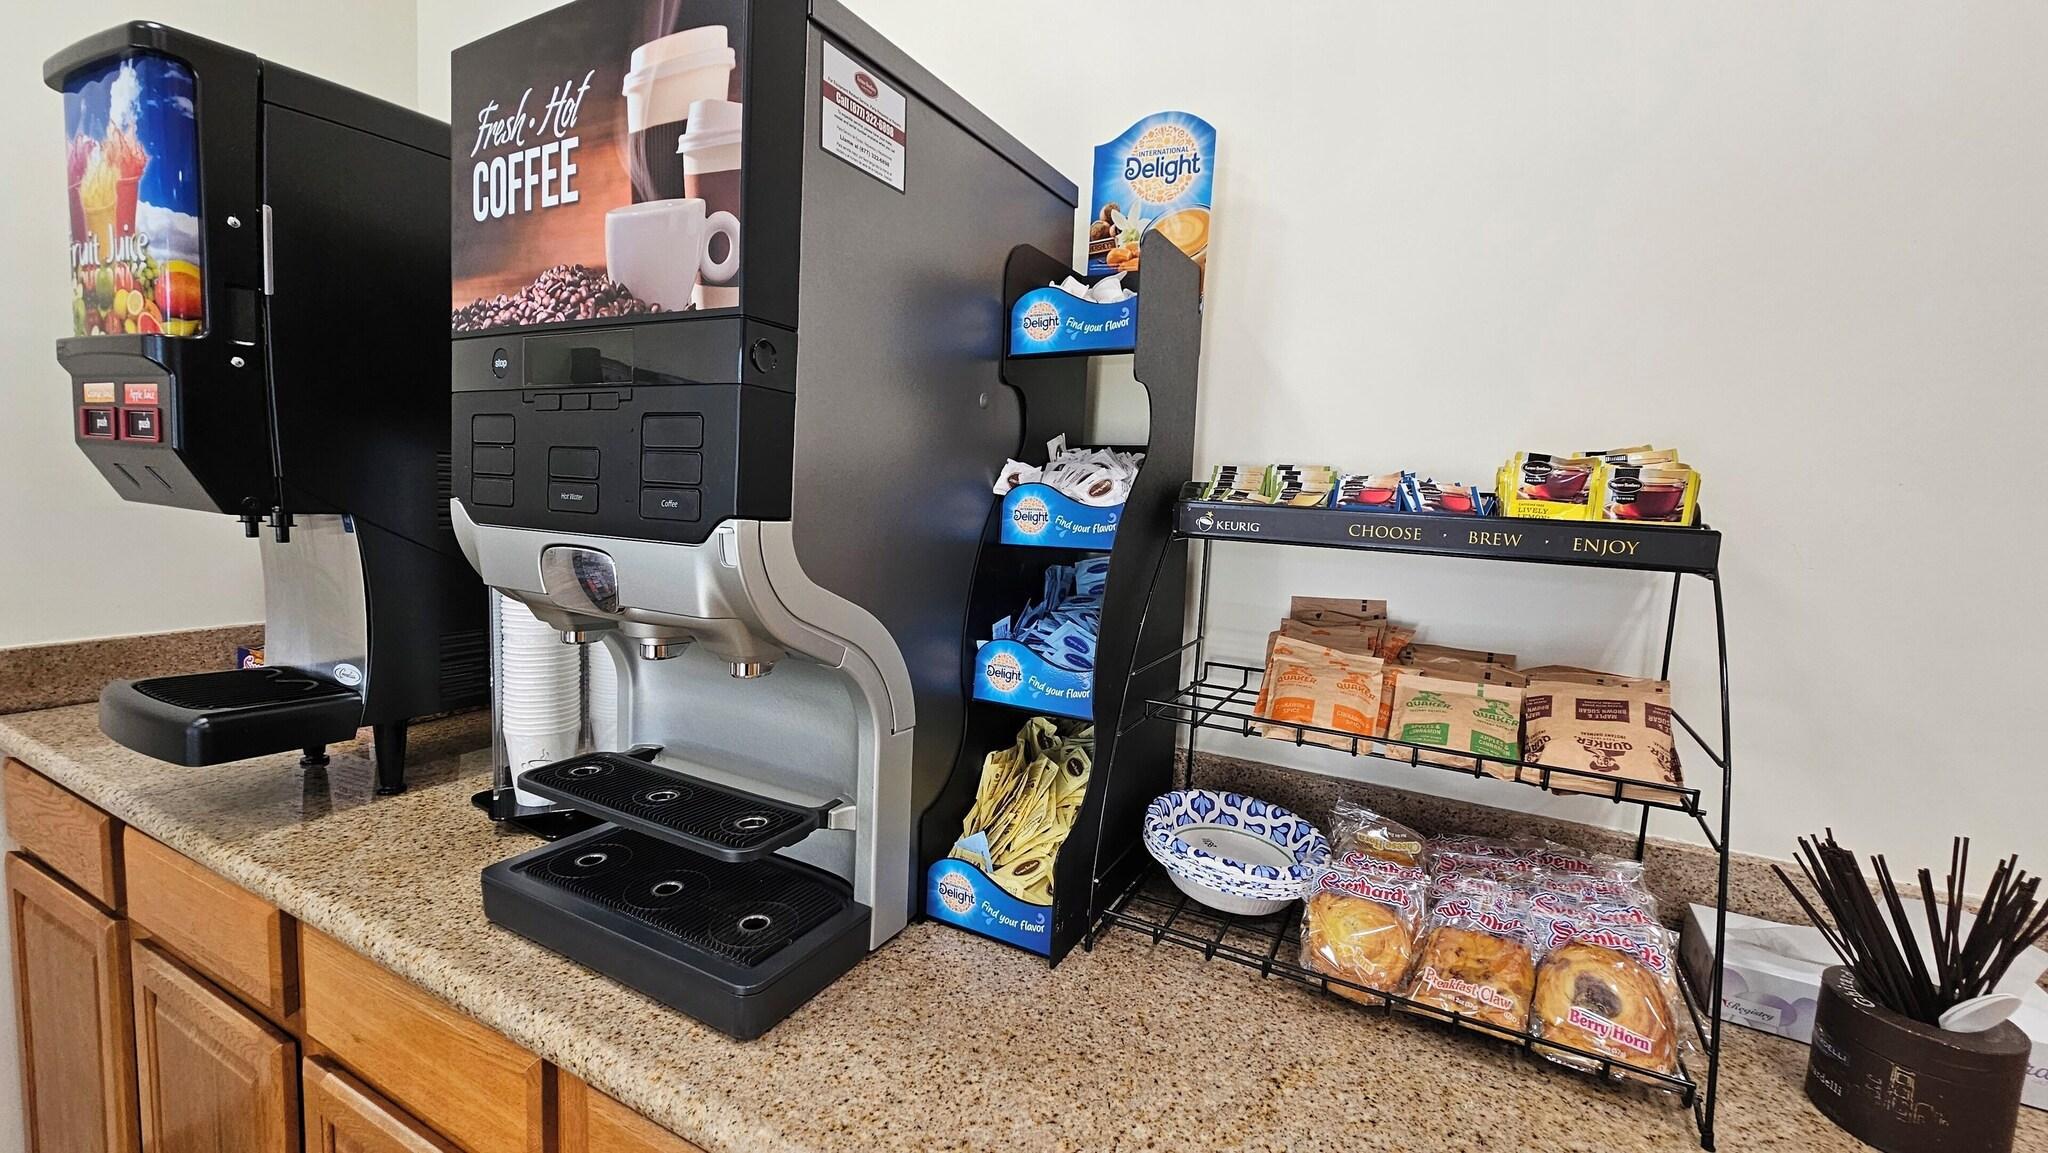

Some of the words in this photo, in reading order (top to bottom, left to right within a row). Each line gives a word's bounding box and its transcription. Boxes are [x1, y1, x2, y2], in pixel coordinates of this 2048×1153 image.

[471, 88, 533, 158] Fresh
[536, 69, 595, 138] Hot
[835, 91, 850, 109] Call
[849, 97, 865, 120] (877)
[1138, 146, 1190, 158] INTERNATIONAL
[1124, 151, 1201, 185] Delight
[473, 136, 579, 222] COFFEE
[106, 223, 150, 264] Juice
[1023, 315, 1060, 331] Delight
[1066, 316, 1083, 330] Find
[1083, 323, 1103, 334] your
[494, 358, 508, 369] stop
[560, 493, 569, 501] Hot
[569, 493, 584, 501] Water
[660, 499, 679, 509] Coffee
[1013, 509, 1049, 525] Delight
[1518, 507, 1549, 515] LIVELY
[1055, 514, 1073, 529] Find
[1072, 524, 1091, 534] your
[1216, 520, 1261, 533] KEURIG
[1348, 524, 1422, 541] CHOOSE
[1468, 530, 1523, 547] BREW
[1573, 537, 1640, 557] ENJOY
[986, 664, 1023, 683] Delight
[1277, 674, 1318, 685] QUAKER
[1028, 675, 1045, 691] Find
[1045, 686, 1065, 697] your
[1336, 682, 1376, 700] QUAKER
[1406, 701, 1452, 709] QUAKER
[1472, 709, 1520, 727] QUAKER
[1480, 734, 1504, 746] APPLES
[1576, 736, 1633, 751] QUAKER
[938, 881, 976, 905] Delight
[980, 900, 1000, 920] Find
[998, 914, 1020, 928] your
[1424, 966, 1478, 997] Breakfast
[1480, 986, 1513, 1009] Claw
[1728, 1001, 1775, 1021] Registry
[1570, 1008, 1609, 1037] Berry
[1612, 1025, 1650, 1051] Horn
